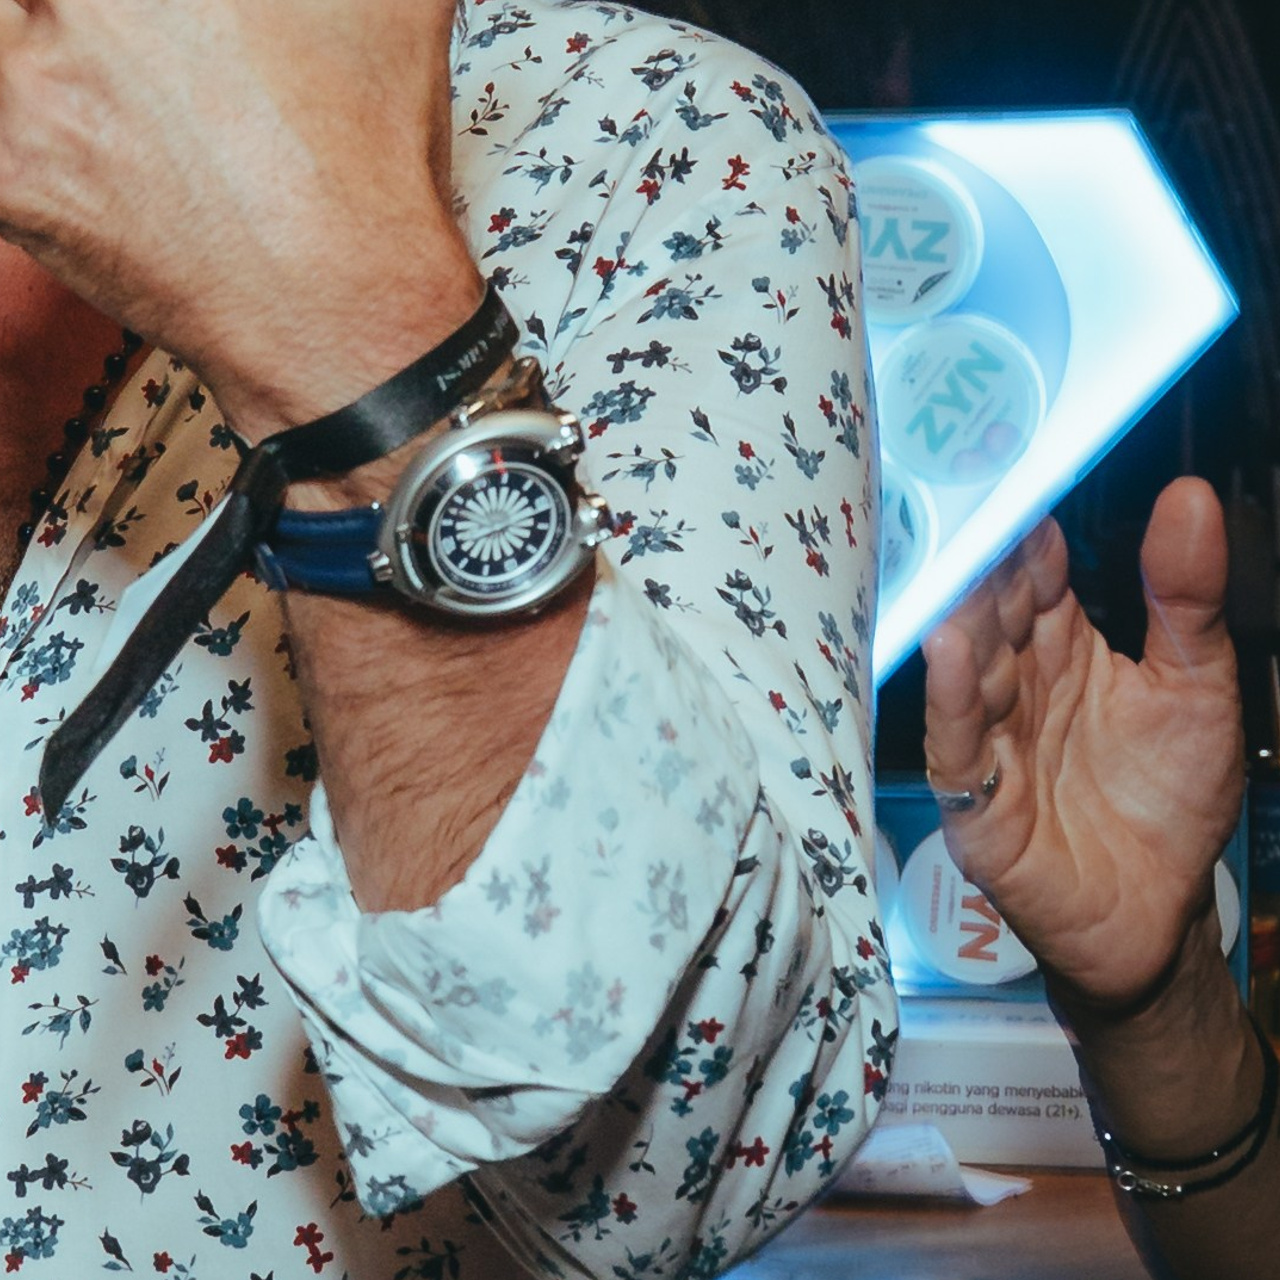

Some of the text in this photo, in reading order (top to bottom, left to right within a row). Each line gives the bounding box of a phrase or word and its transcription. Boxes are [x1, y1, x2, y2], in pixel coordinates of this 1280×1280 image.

[904, 340, 1006, 455] ZYN
[958, 893, 1002, 962] YN
[912, 1102, 983, 1116] pengguna
[987, 1101, 1041, 1116] dewasa
[914, 1081, 960, 1094] nikotin
[965, 1084, 1000, 1098] yang
